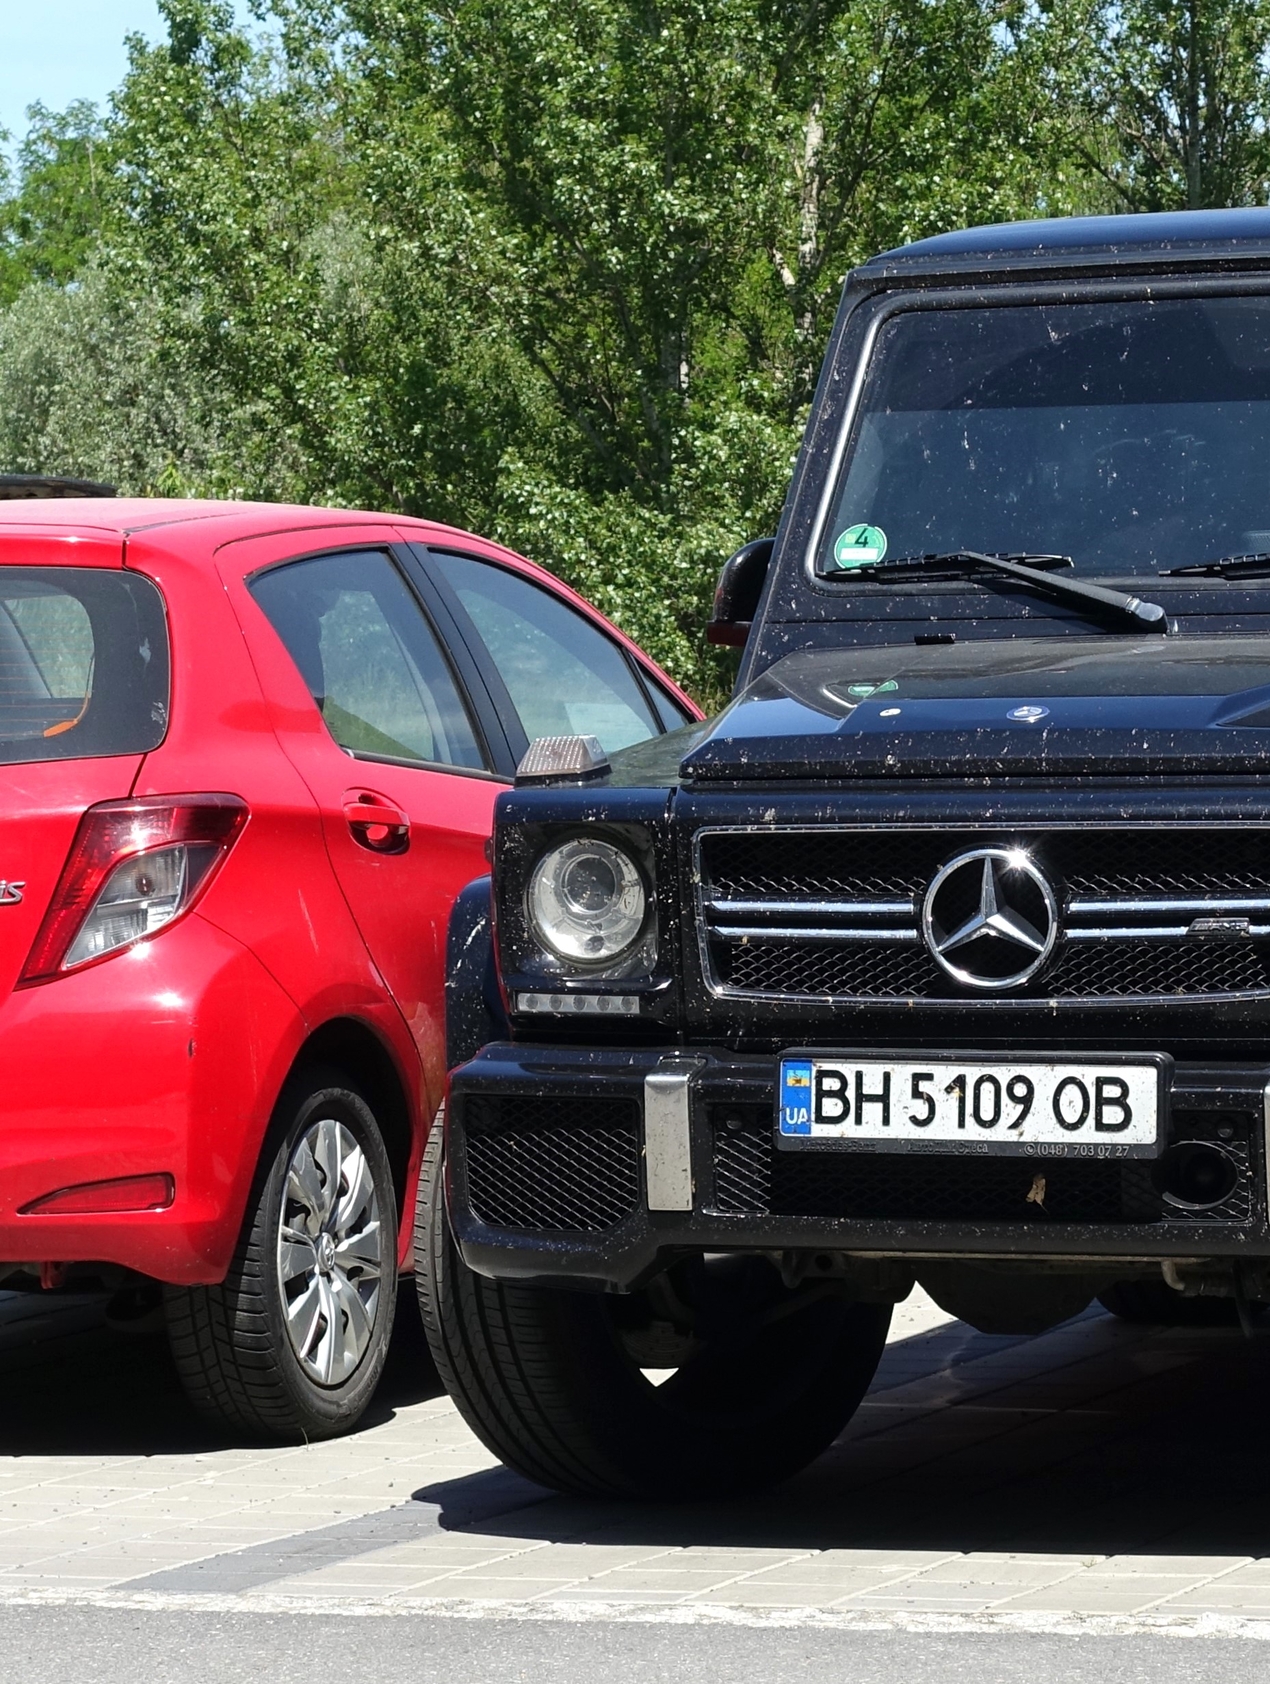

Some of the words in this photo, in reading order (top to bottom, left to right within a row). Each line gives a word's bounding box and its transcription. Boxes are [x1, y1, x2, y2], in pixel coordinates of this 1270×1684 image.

[854, 527, 868, 548] 4
[814, 1069, 891, 1127] BH
[908, 1072, 1036, 1130] 5109
[1051, 1075, 1133, 1132] OB
[785, 1107, 809, 1125] UA
[1037, 1144, 1068, 1156] (048)
[1073, 1145, 1095, 1156] 703
[1097, 1146, 1112, 1157] 07
[1115, 1146, 1130, 1157] 27
